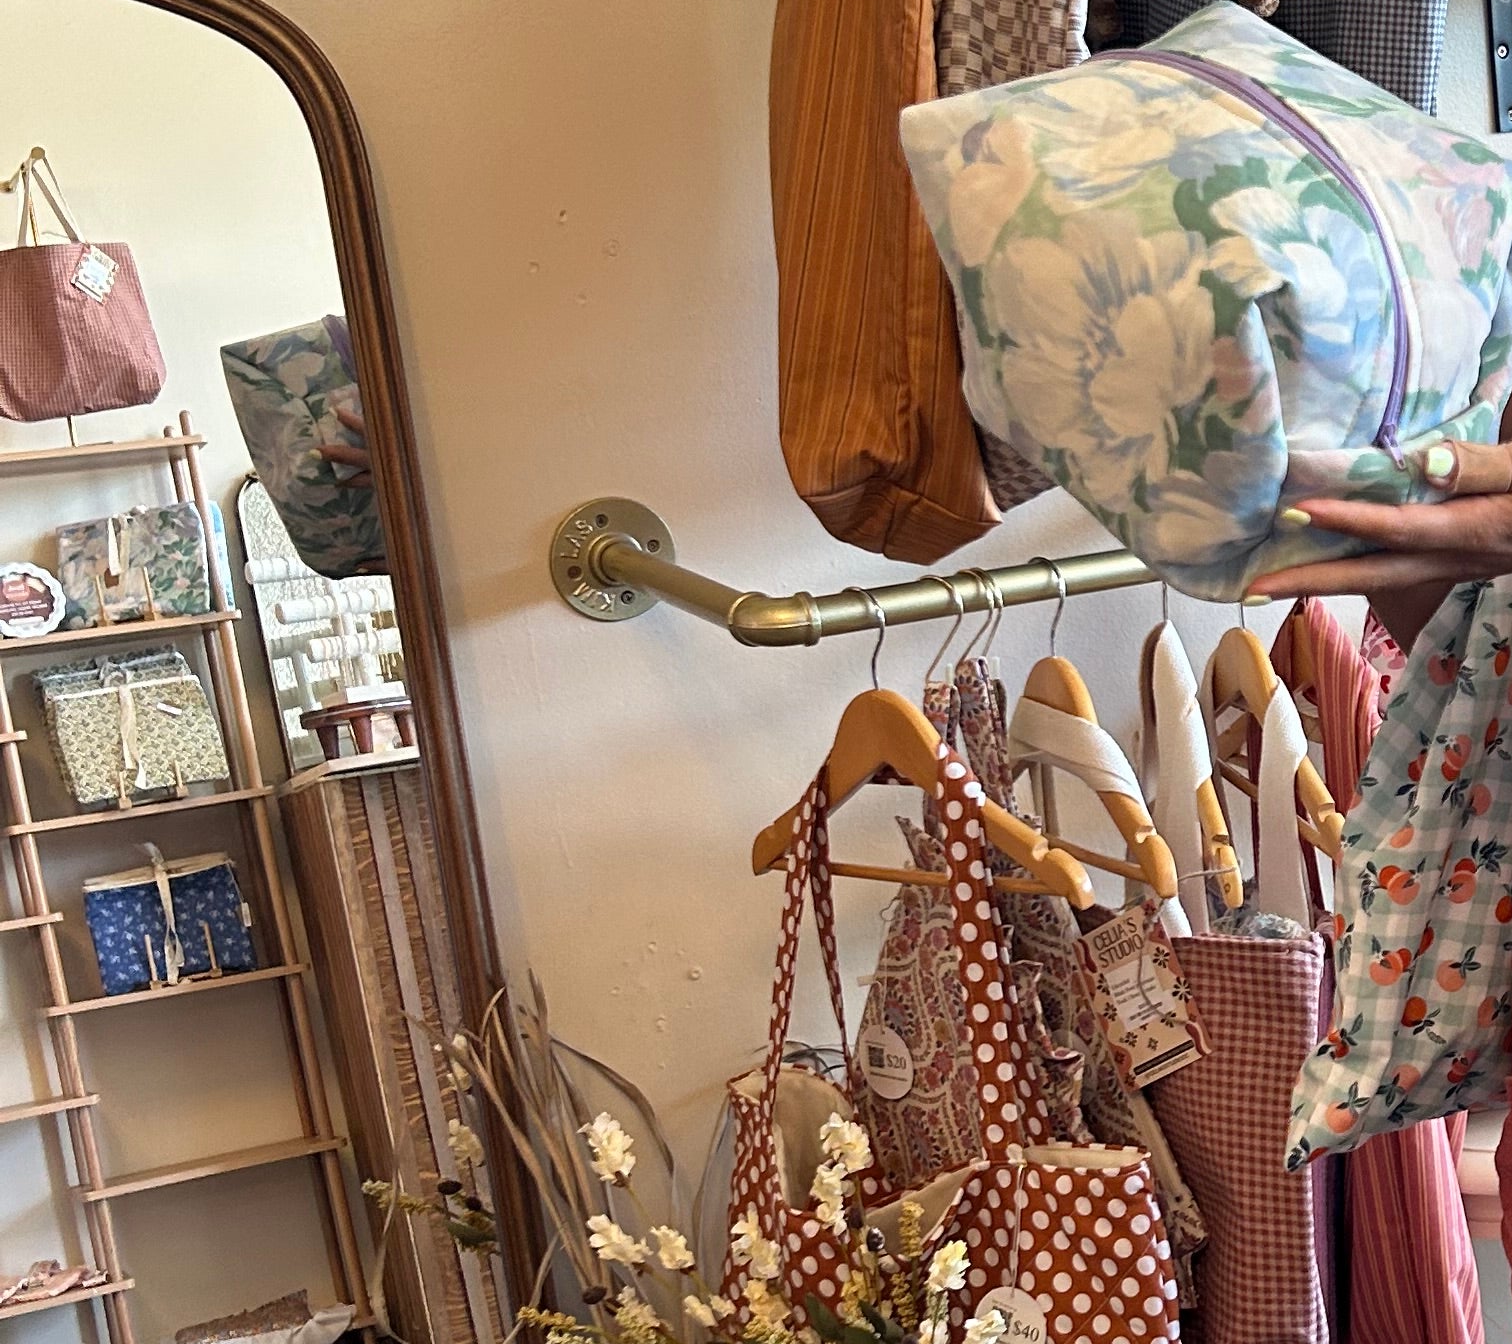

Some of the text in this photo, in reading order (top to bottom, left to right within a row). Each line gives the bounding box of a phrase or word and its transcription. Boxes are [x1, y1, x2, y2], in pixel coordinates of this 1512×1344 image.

[1093, 917, 1138, 952] CELIA'S
[1098, 934, 1145, 969] STUDIO
[886, 1054, 907, 1070] $20
[1012, 1319, 1040, 1343] $40
